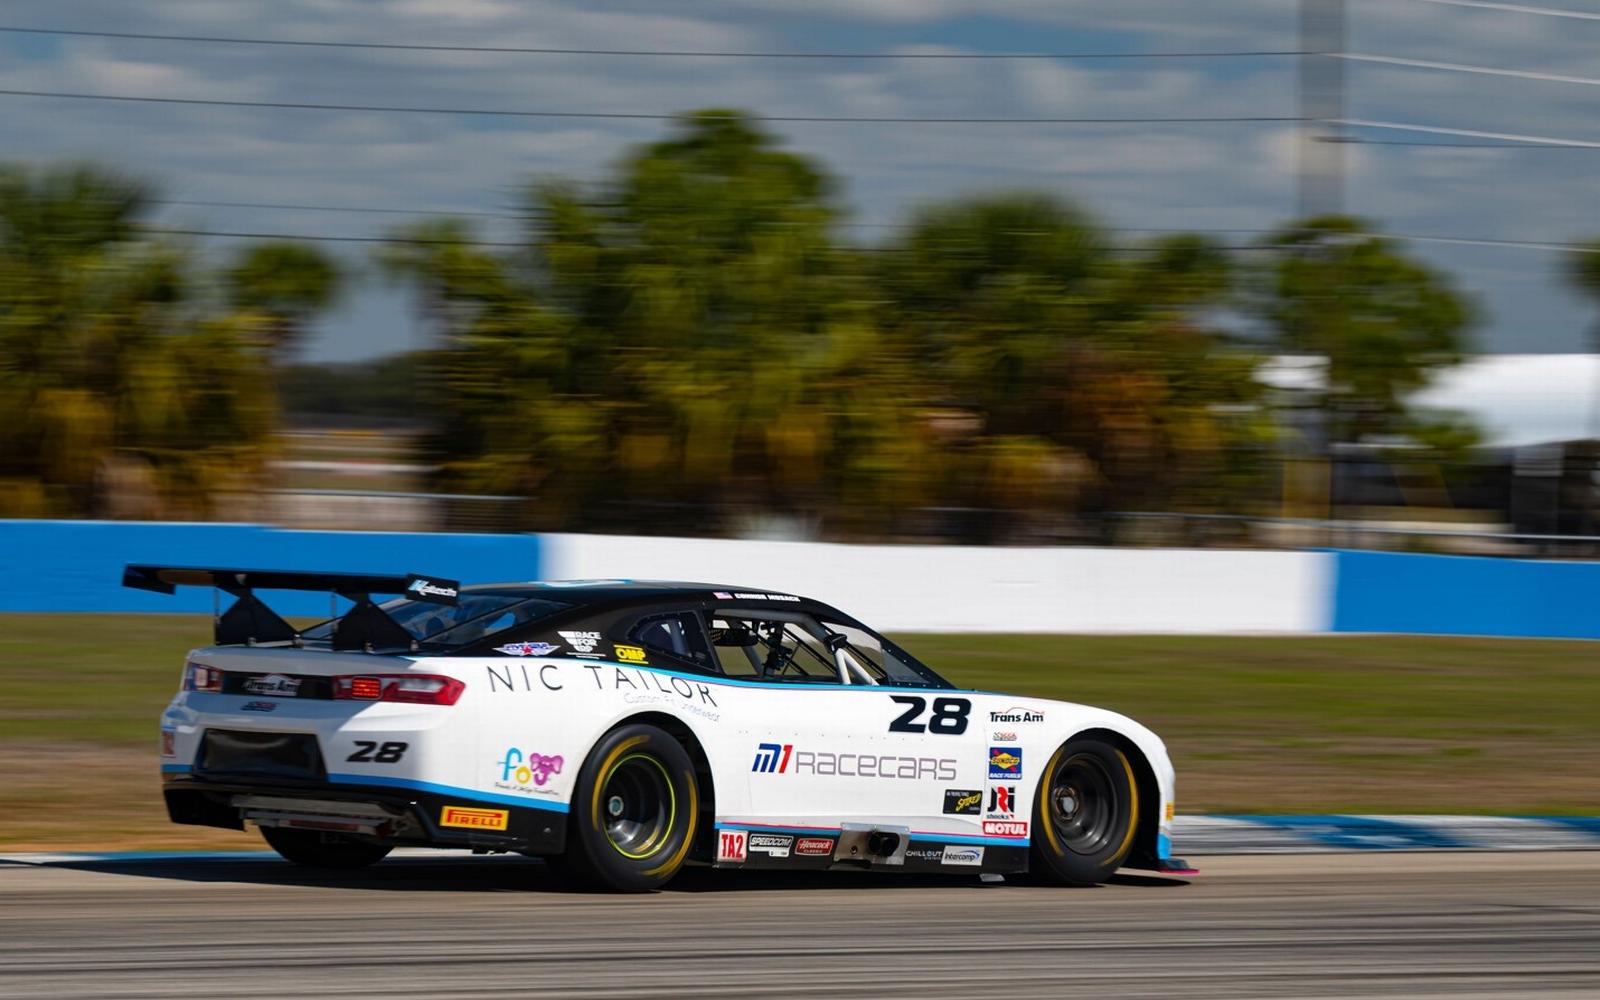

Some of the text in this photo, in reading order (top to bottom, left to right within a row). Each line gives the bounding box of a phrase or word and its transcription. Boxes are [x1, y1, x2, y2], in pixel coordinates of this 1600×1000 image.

[576, 631, 602, 639] RACE
[615, 648, 646, 660] OMP
[487, 665, 718, 707] NIC TAILOR
[888, 694, 972, 735] 28
[990, 712, 1044, 722] Trans Am
[346, 740, 409, 763] 28
[447, 809, 503, 826] PIRELLI
[985, 822, 1026, 835] MOTUL
[721, 833, 744, 859] TA2
[751, 836, 792, 846] SPEEDCOM
[945, 851, 976, 862] Intercomp
